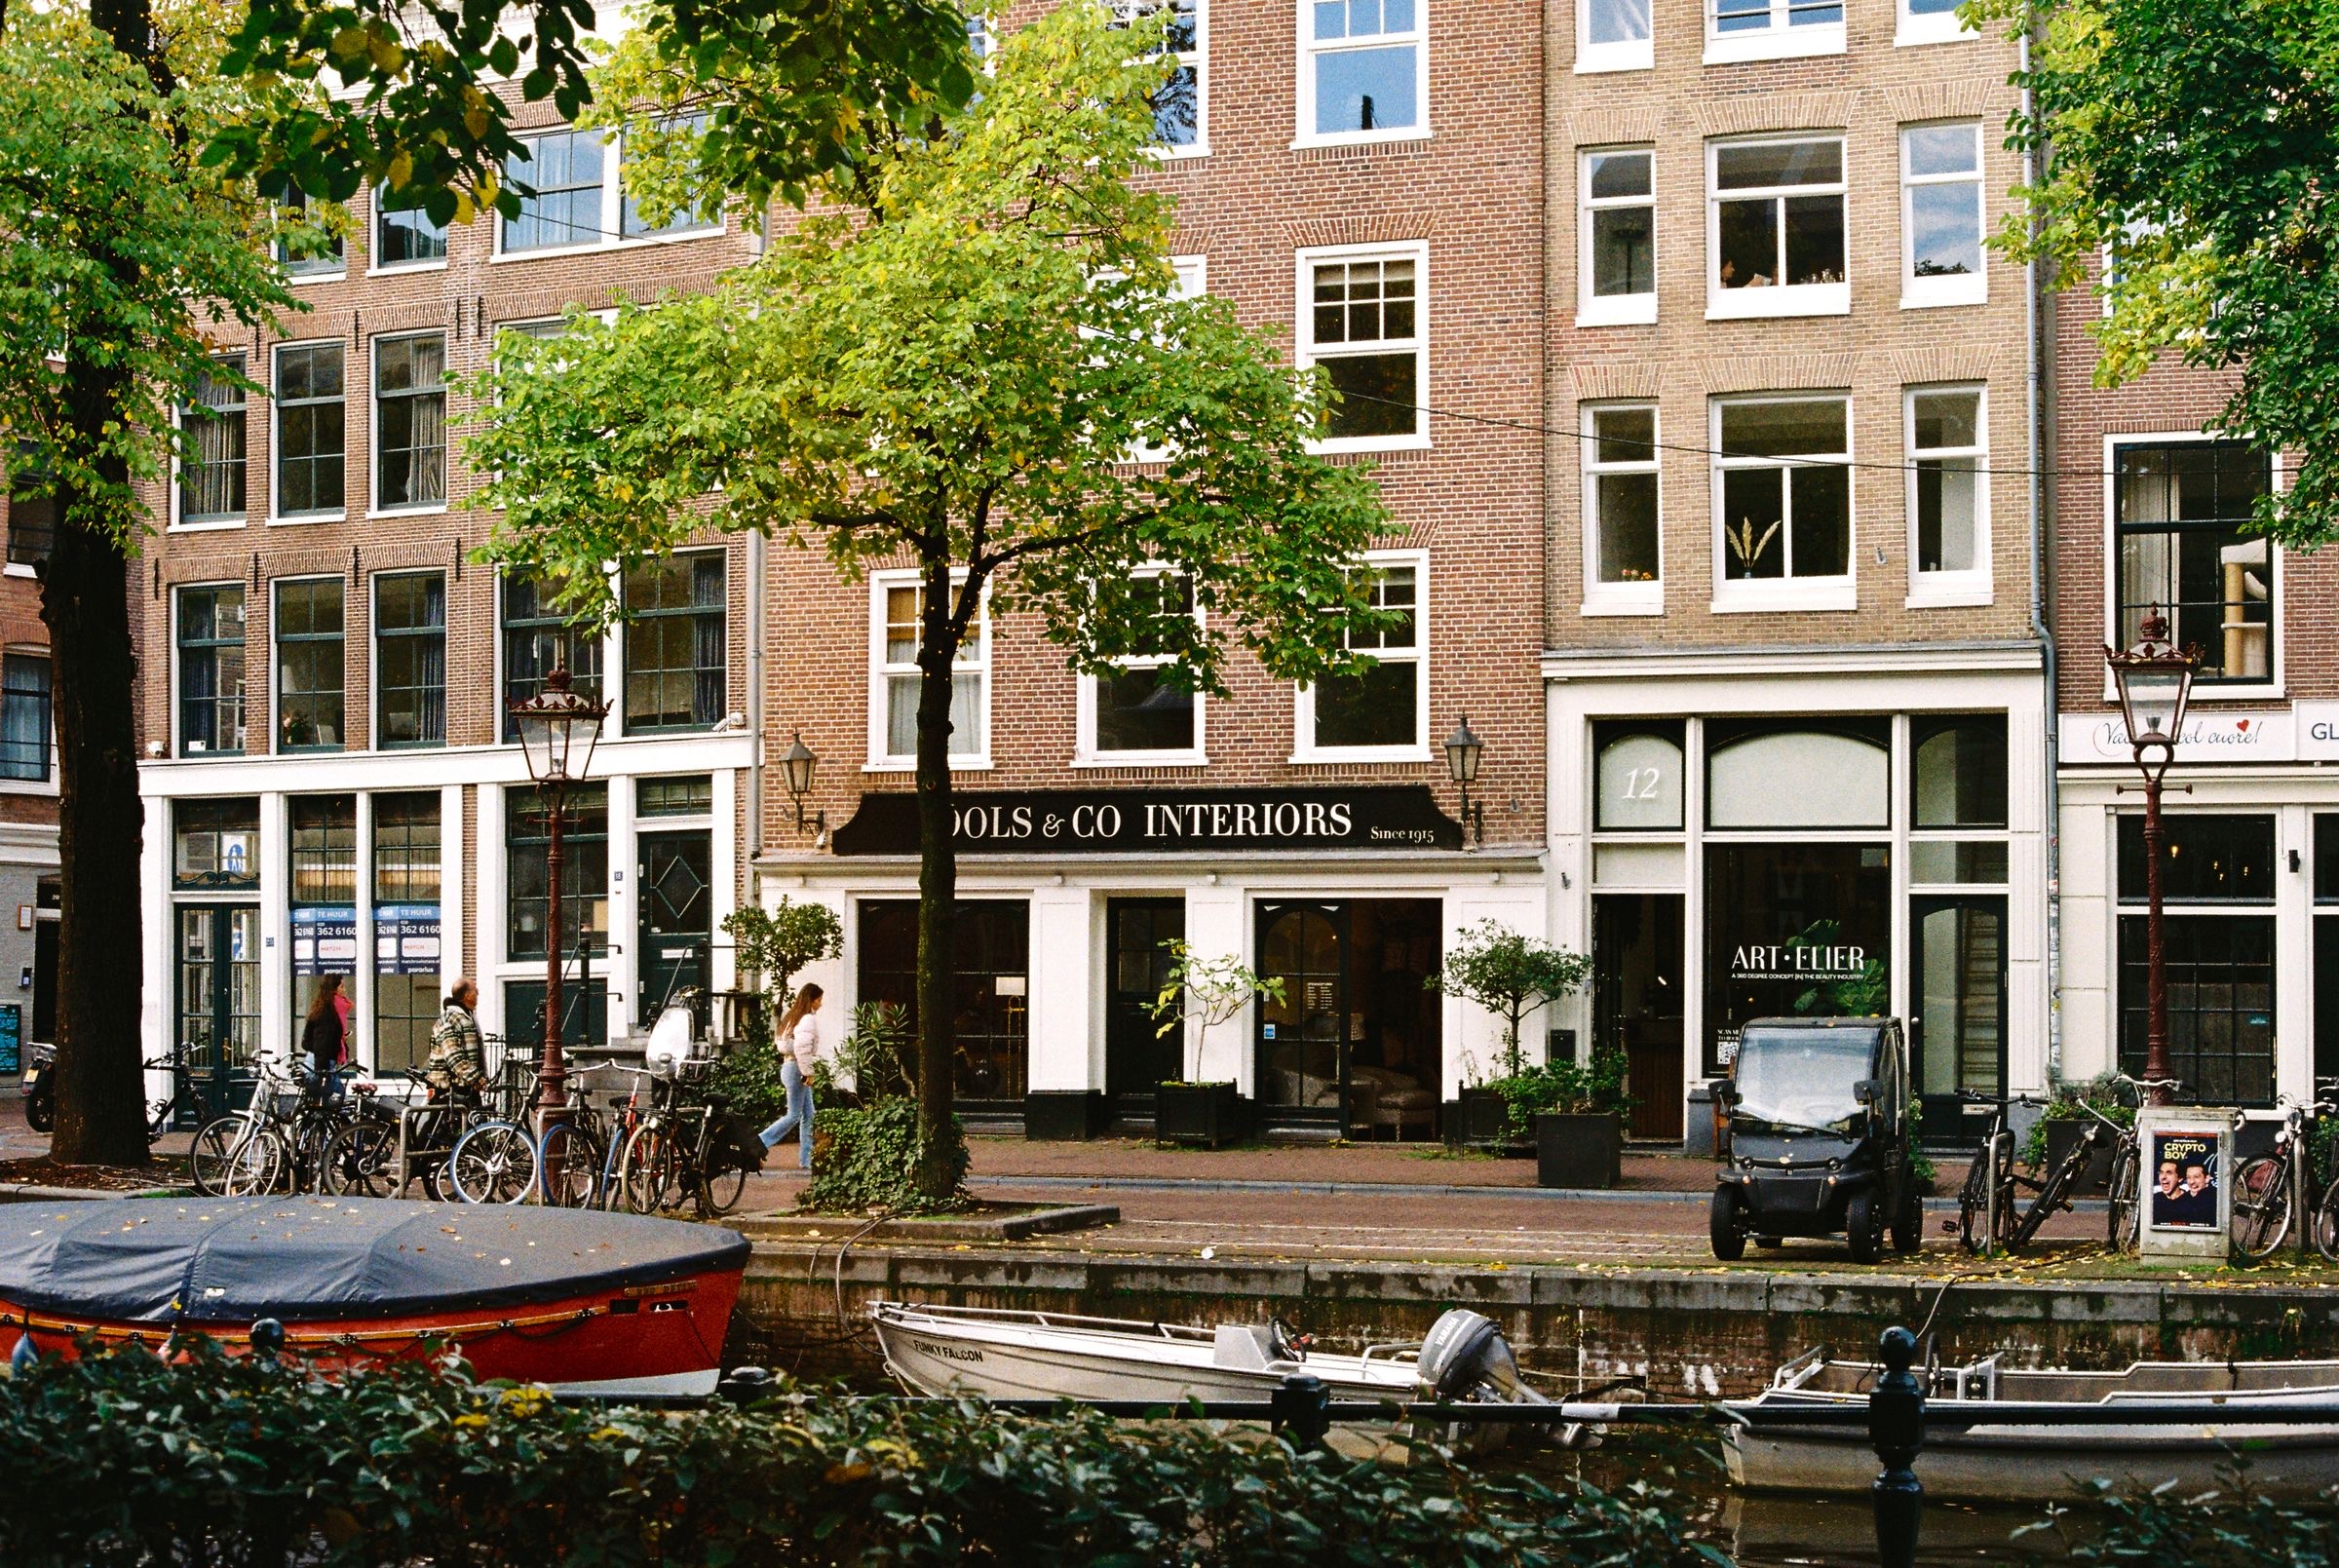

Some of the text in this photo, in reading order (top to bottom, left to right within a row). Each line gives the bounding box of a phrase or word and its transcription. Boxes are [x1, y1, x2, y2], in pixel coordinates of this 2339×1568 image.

[2208, 720, 2263, 745] cuore!
[1622, 768, 1659, 799] 12
[1042, 813, 1065, 838] &
[1072, 805, 1121, 838] CO
[1143, 802, 1352, 837] INTERIORS
[1370, 825, 1435, 844] Since 1915
[401, 907, 432, 916] TE HUUR
[317, 927, 356, 936] 362 6160
[401, 925, 441, 934] 362 6160
[2165, 1143, 2206, 1152] CRYPTO
[1435, 1317, 1460, 1346] YAMAHA
[913, 1340, 983, 1362] FUNKY FALCON
